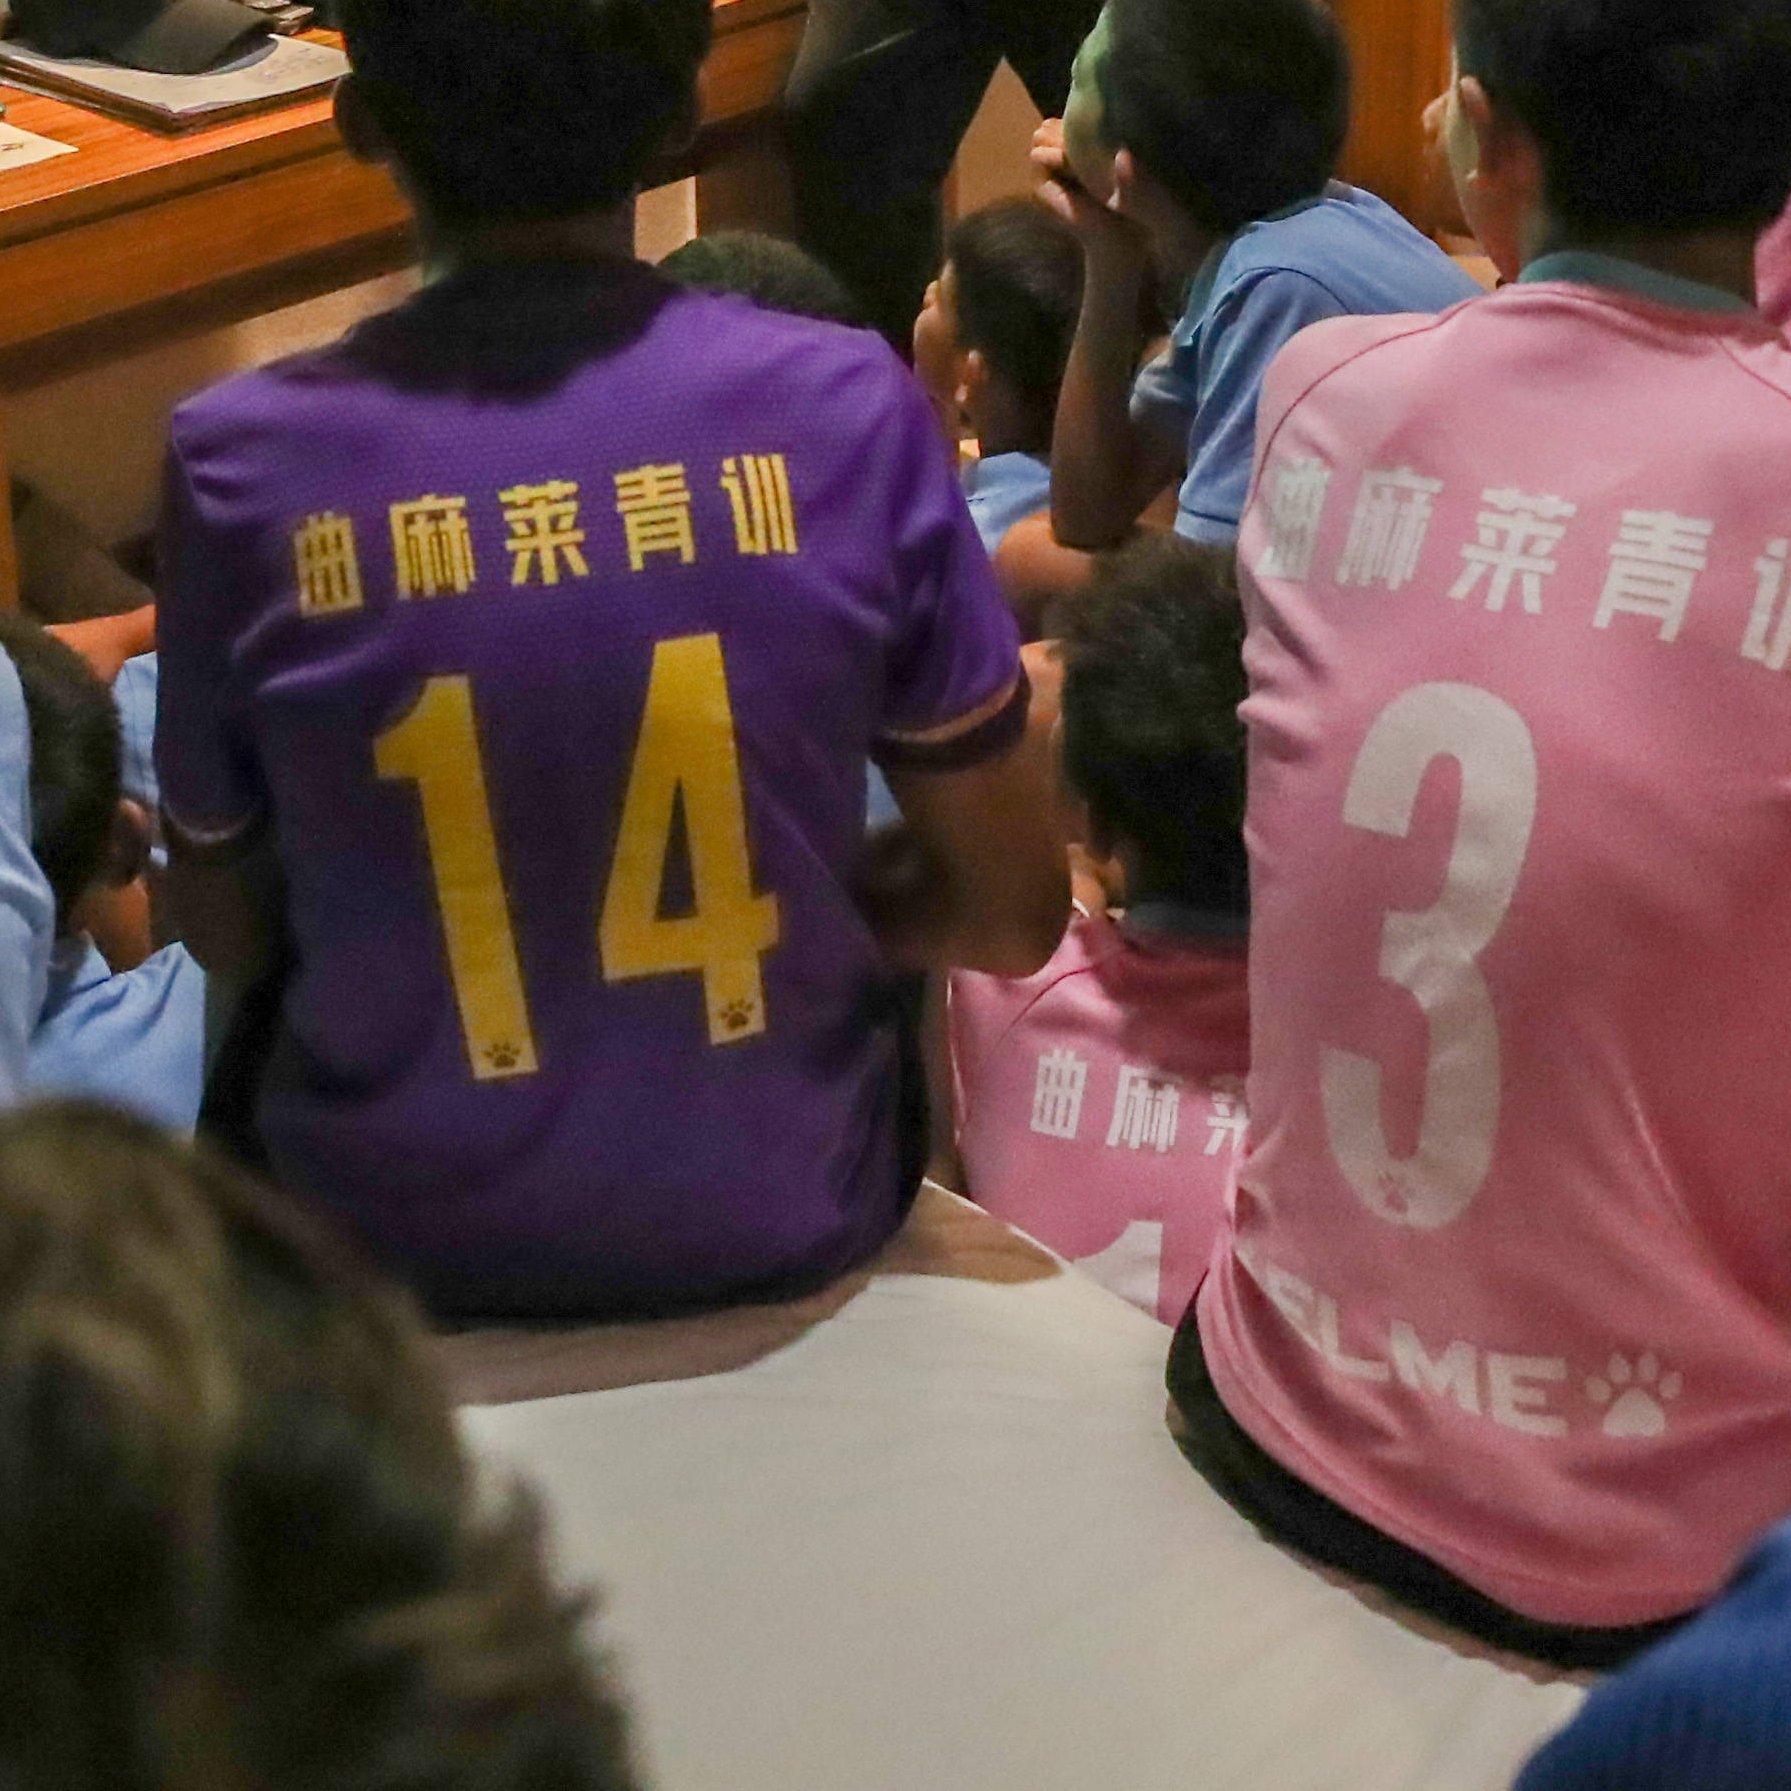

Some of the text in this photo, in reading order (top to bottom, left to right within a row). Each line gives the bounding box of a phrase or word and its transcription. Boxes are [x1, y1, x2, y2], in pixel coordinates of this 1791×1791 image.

[294, 453, 798, 619] 曲麻莱青训
[372, 631, 780, 1082] 14
[1317, 681, 1539, 1229] 3
